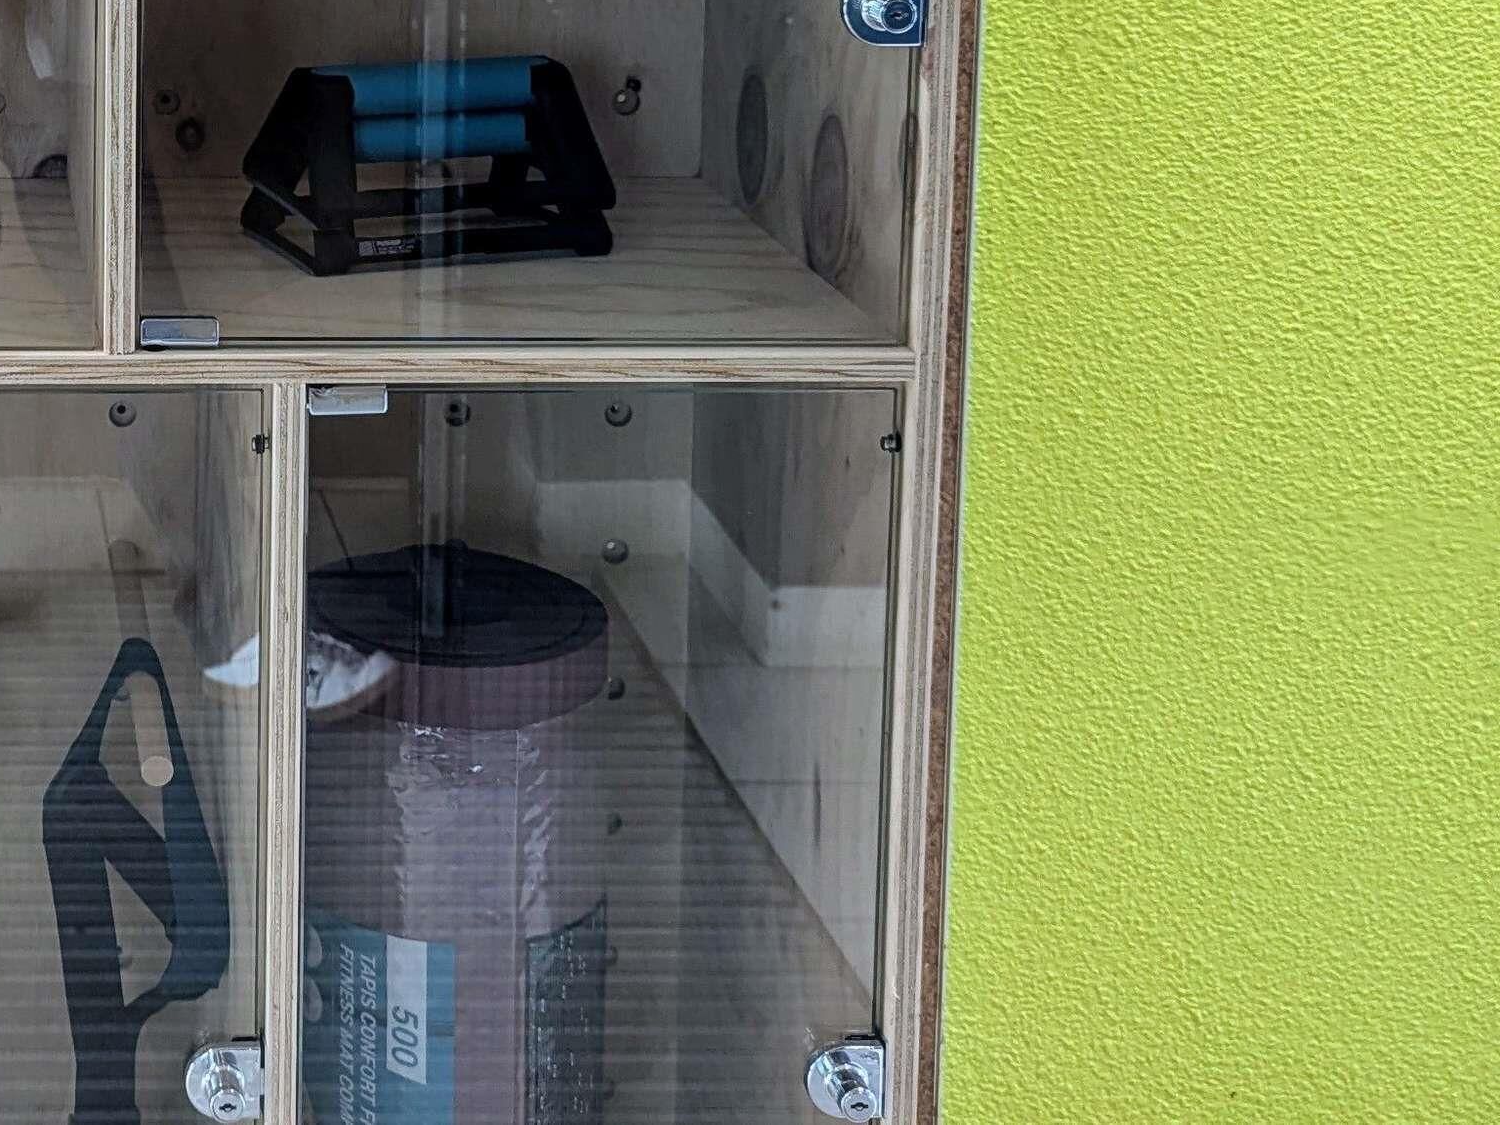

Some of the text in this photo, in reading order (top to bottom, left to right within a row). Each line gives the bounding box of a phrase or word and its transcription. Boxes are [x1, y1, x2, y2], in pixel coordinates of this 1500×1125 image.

[359, 953, 377, 1010] TAPIS
[359, 1011, 377, 1107] CONFORT
[391, 1005, 419, 1068] 500
